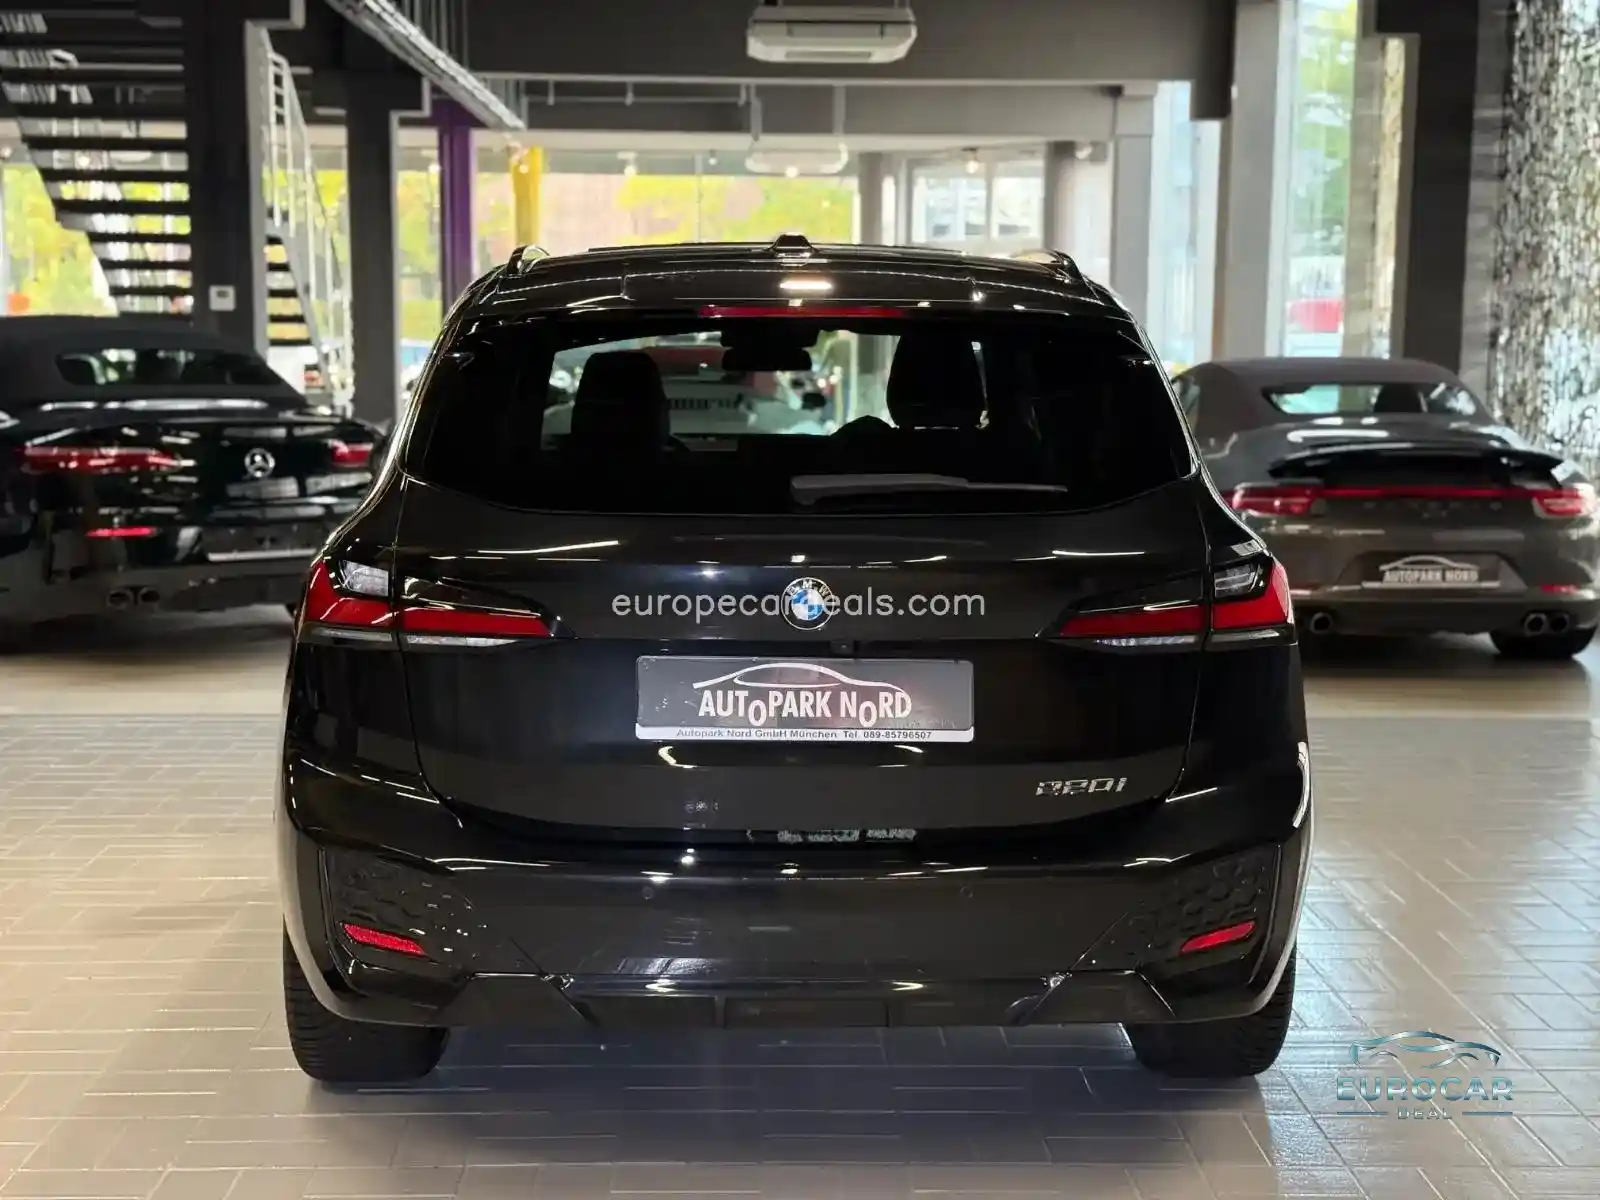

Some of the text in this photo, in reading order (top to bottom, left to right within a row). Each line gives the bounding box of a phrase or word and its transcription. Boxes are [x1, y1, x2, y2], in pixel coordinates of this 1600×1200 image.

[786, 579, 830, 597] BMW
[698, 690, 912, 727] AUTOPARK NORD
[676, 728, 724, 738] Autopark
[726, 729, 752, 738] Nord
[754, 729, 787, 738] GmbH
[789, 729, 837, 739] München
[863, 731, 932, 739] 089-85796507
